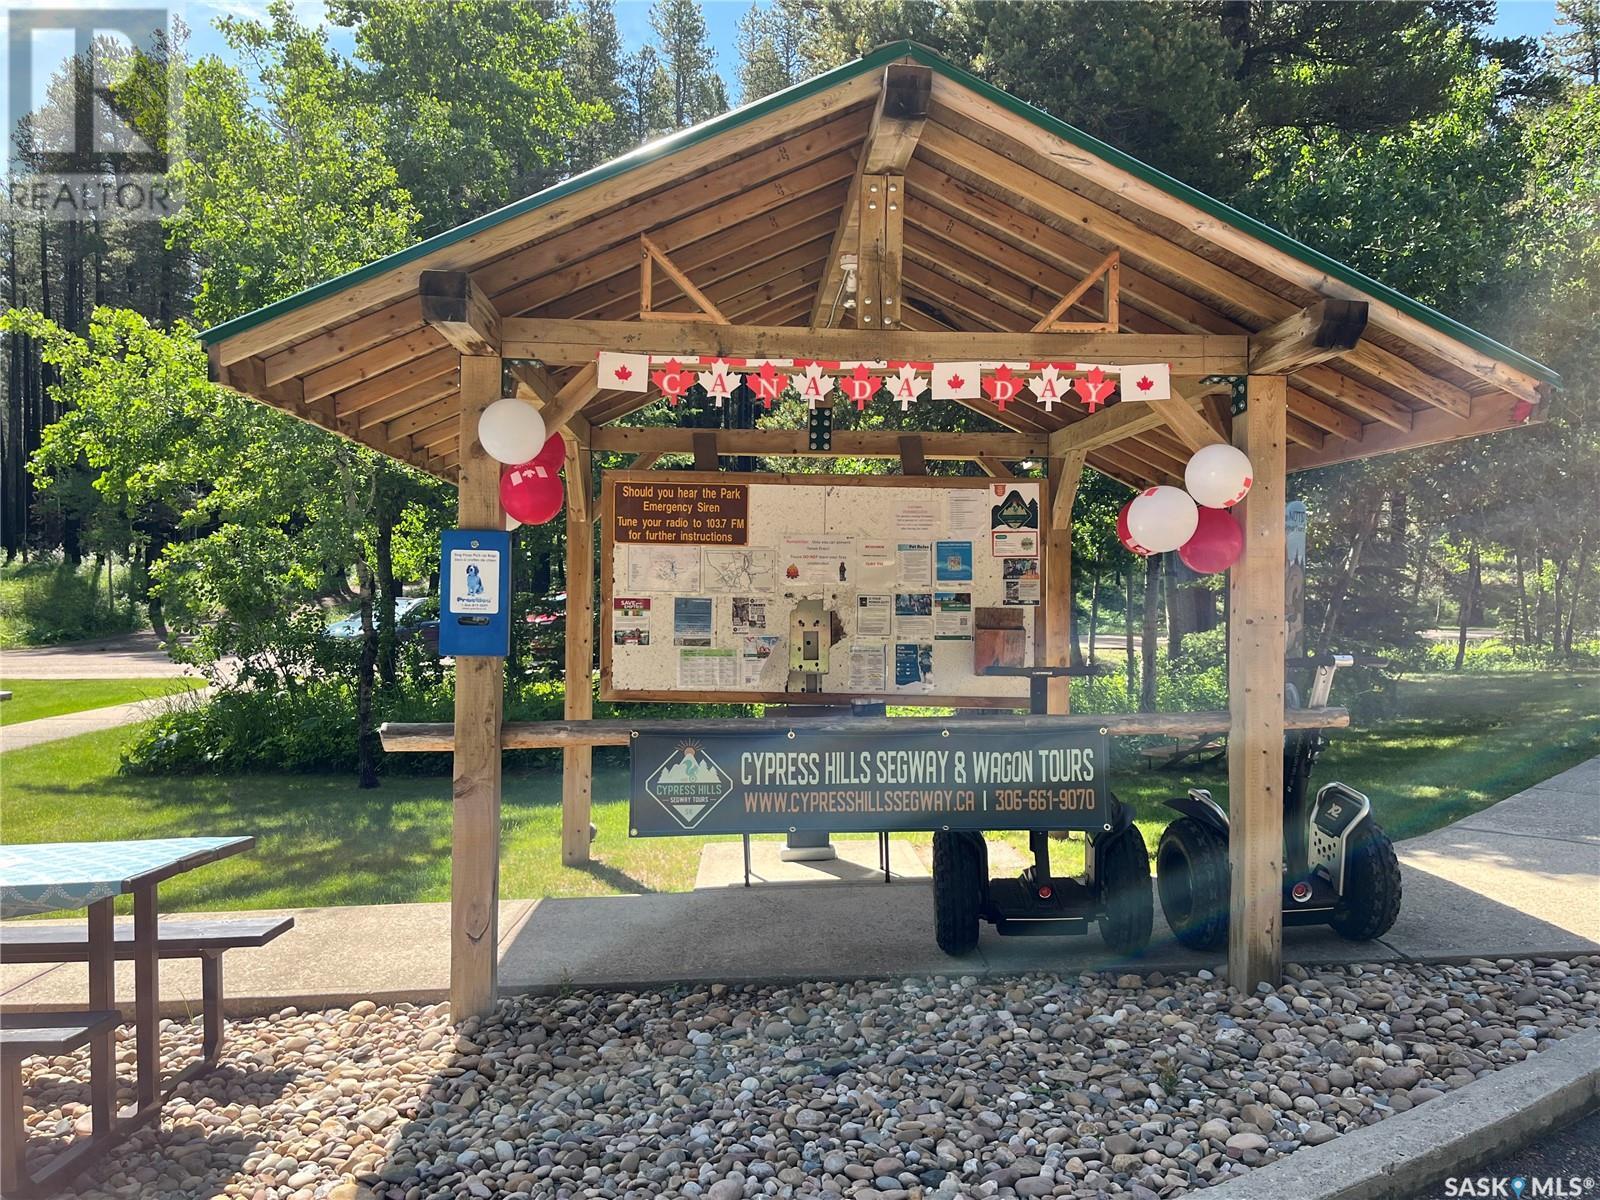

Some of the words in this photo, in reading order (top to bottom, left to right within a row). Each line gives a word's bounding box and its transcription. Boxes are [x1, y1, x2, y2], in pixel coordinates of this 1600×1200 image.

[622, 486, 654, 497] Should
[657, 489, 673, 500] you
[678, 487, 698, 499] hear
[702, 488, 716, 499] the
[720, 488, 741, 499] Park
[643, 501, 693, 514] Emergency
[697, 502, 720, 513] Siren
[617, 516, 638, 527] Tune
[642, 519, 662, 529] your
[666, 518, 689, 528] radio
[693, 519, 702, 528] to
[706, 519, 727, 528] 103.7
[731, 519, 745, 529] FM
[628, 530, 641, 540] for
[646, 530, 676, 540] further
[680, 531, 733, 542] instructions
[741, 752, 820, 785] CYPRESS
[825, 752, 871, 784] HILLS
[876, 751, 949, 784] SEGWAY
[954, 751, 967, 784] &
[972, 750, 1033, 783] WAGON
[1039, 749, 1095, 782] TOURS
[656, 785, 696, 795] CYPRESS
[698, 784, 722, 795] HILLS
[744, 790, 975, 813] WWW.CYPRESSHILLSSEGWAY.CA
[995, 789, 1095, 811] 306-661-9070
